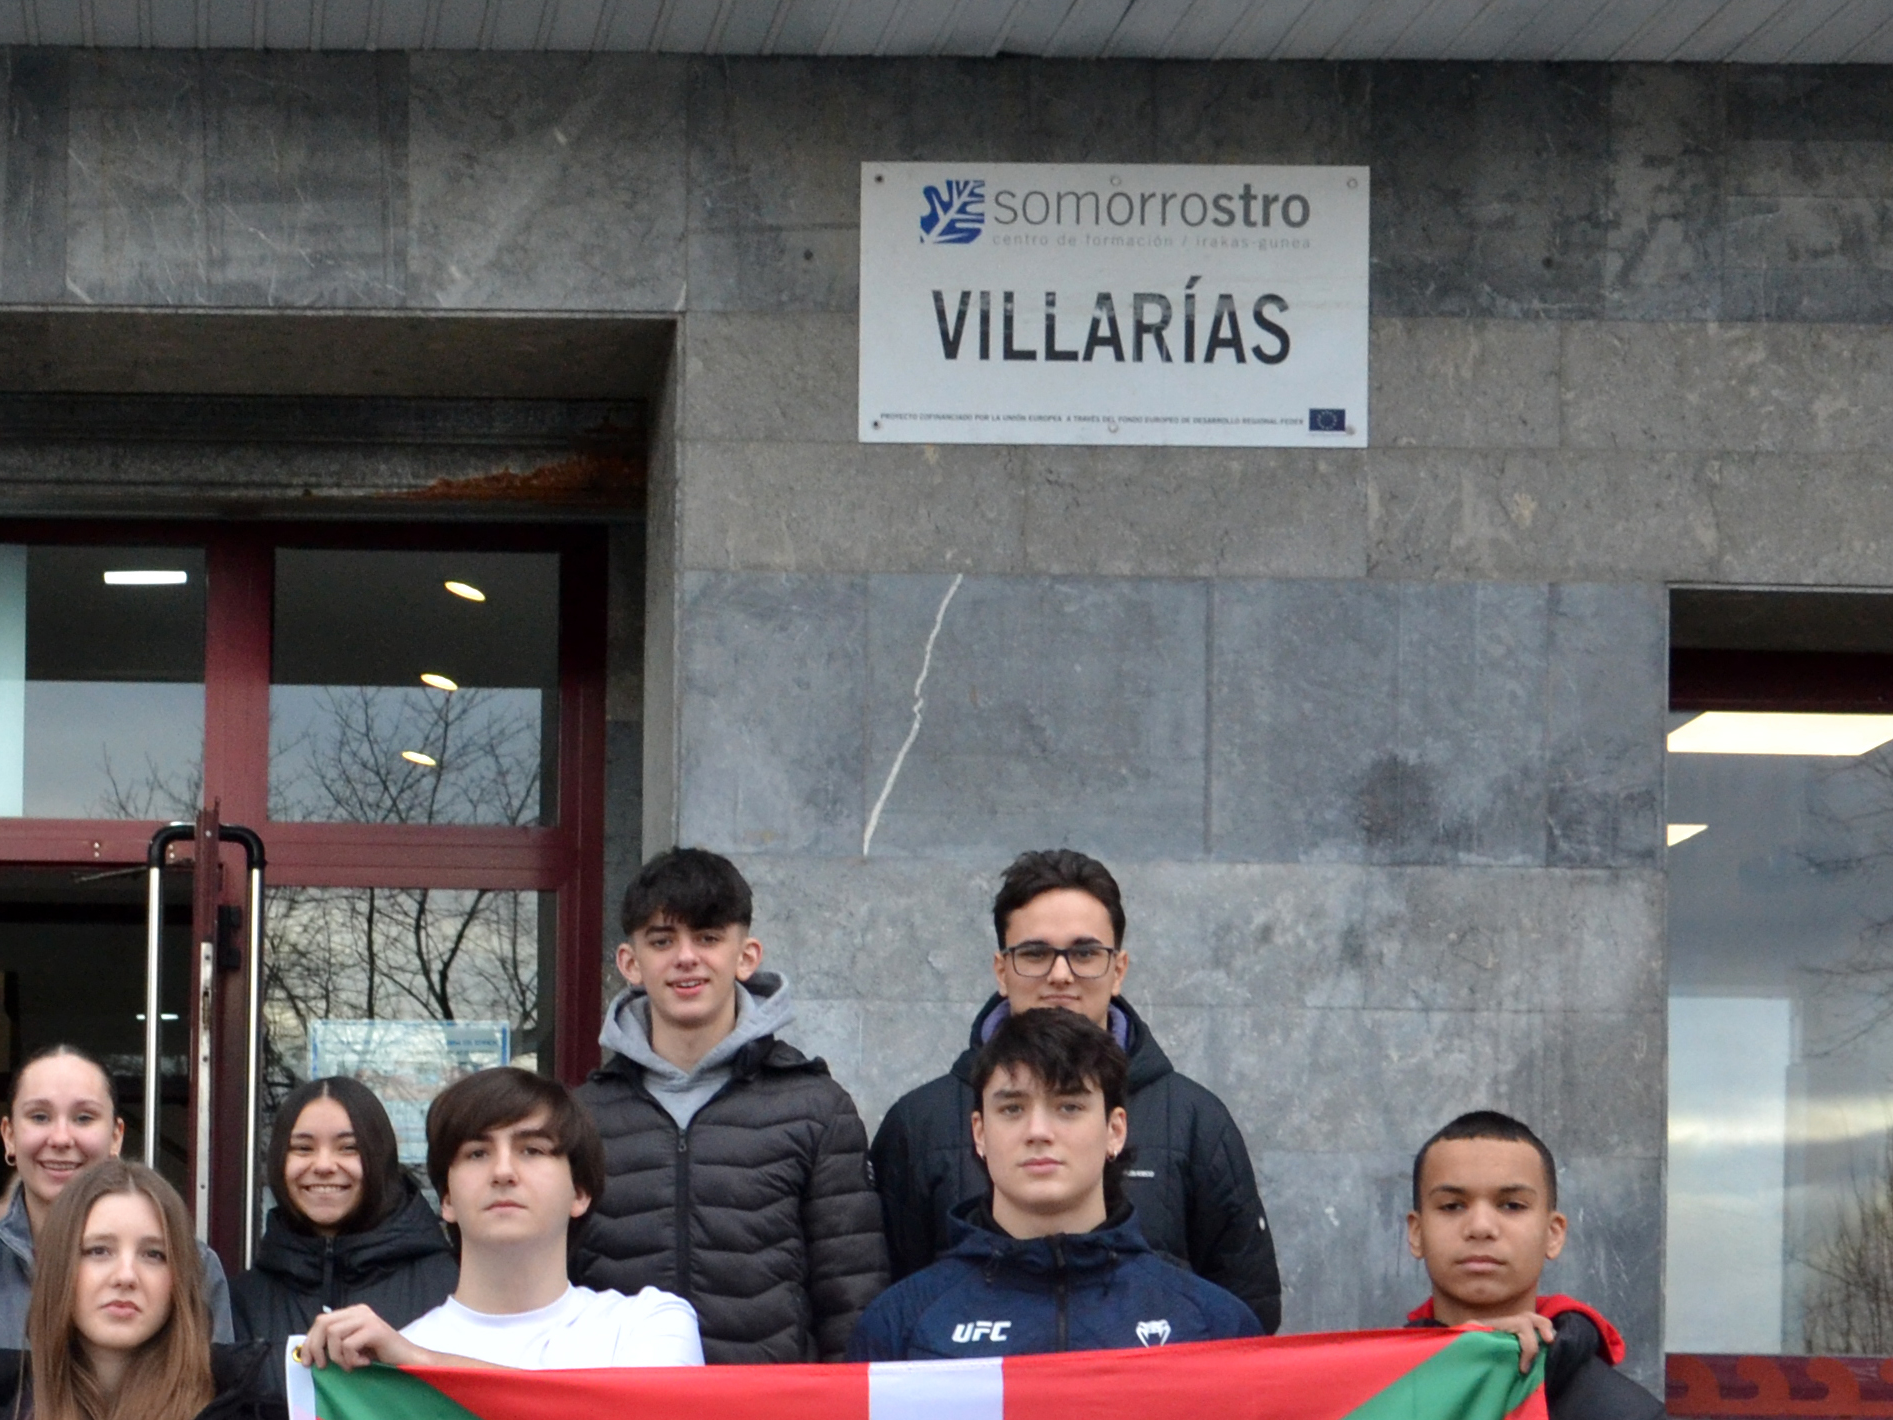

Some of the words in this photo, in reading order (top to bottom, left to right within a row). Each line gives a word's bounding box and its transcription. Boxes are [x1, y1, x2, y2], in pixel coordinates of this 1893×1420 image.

[993, 183, 1311, 229] somorrostro
[992, 233, 1049, 246] centro
[1056, 233, 1077, 246] de
[1085, 233, 1173, 247] formación
[931, 275, 1291, 365] VILLARÍAS
[951, 1319, 1013, 1344] UFC
